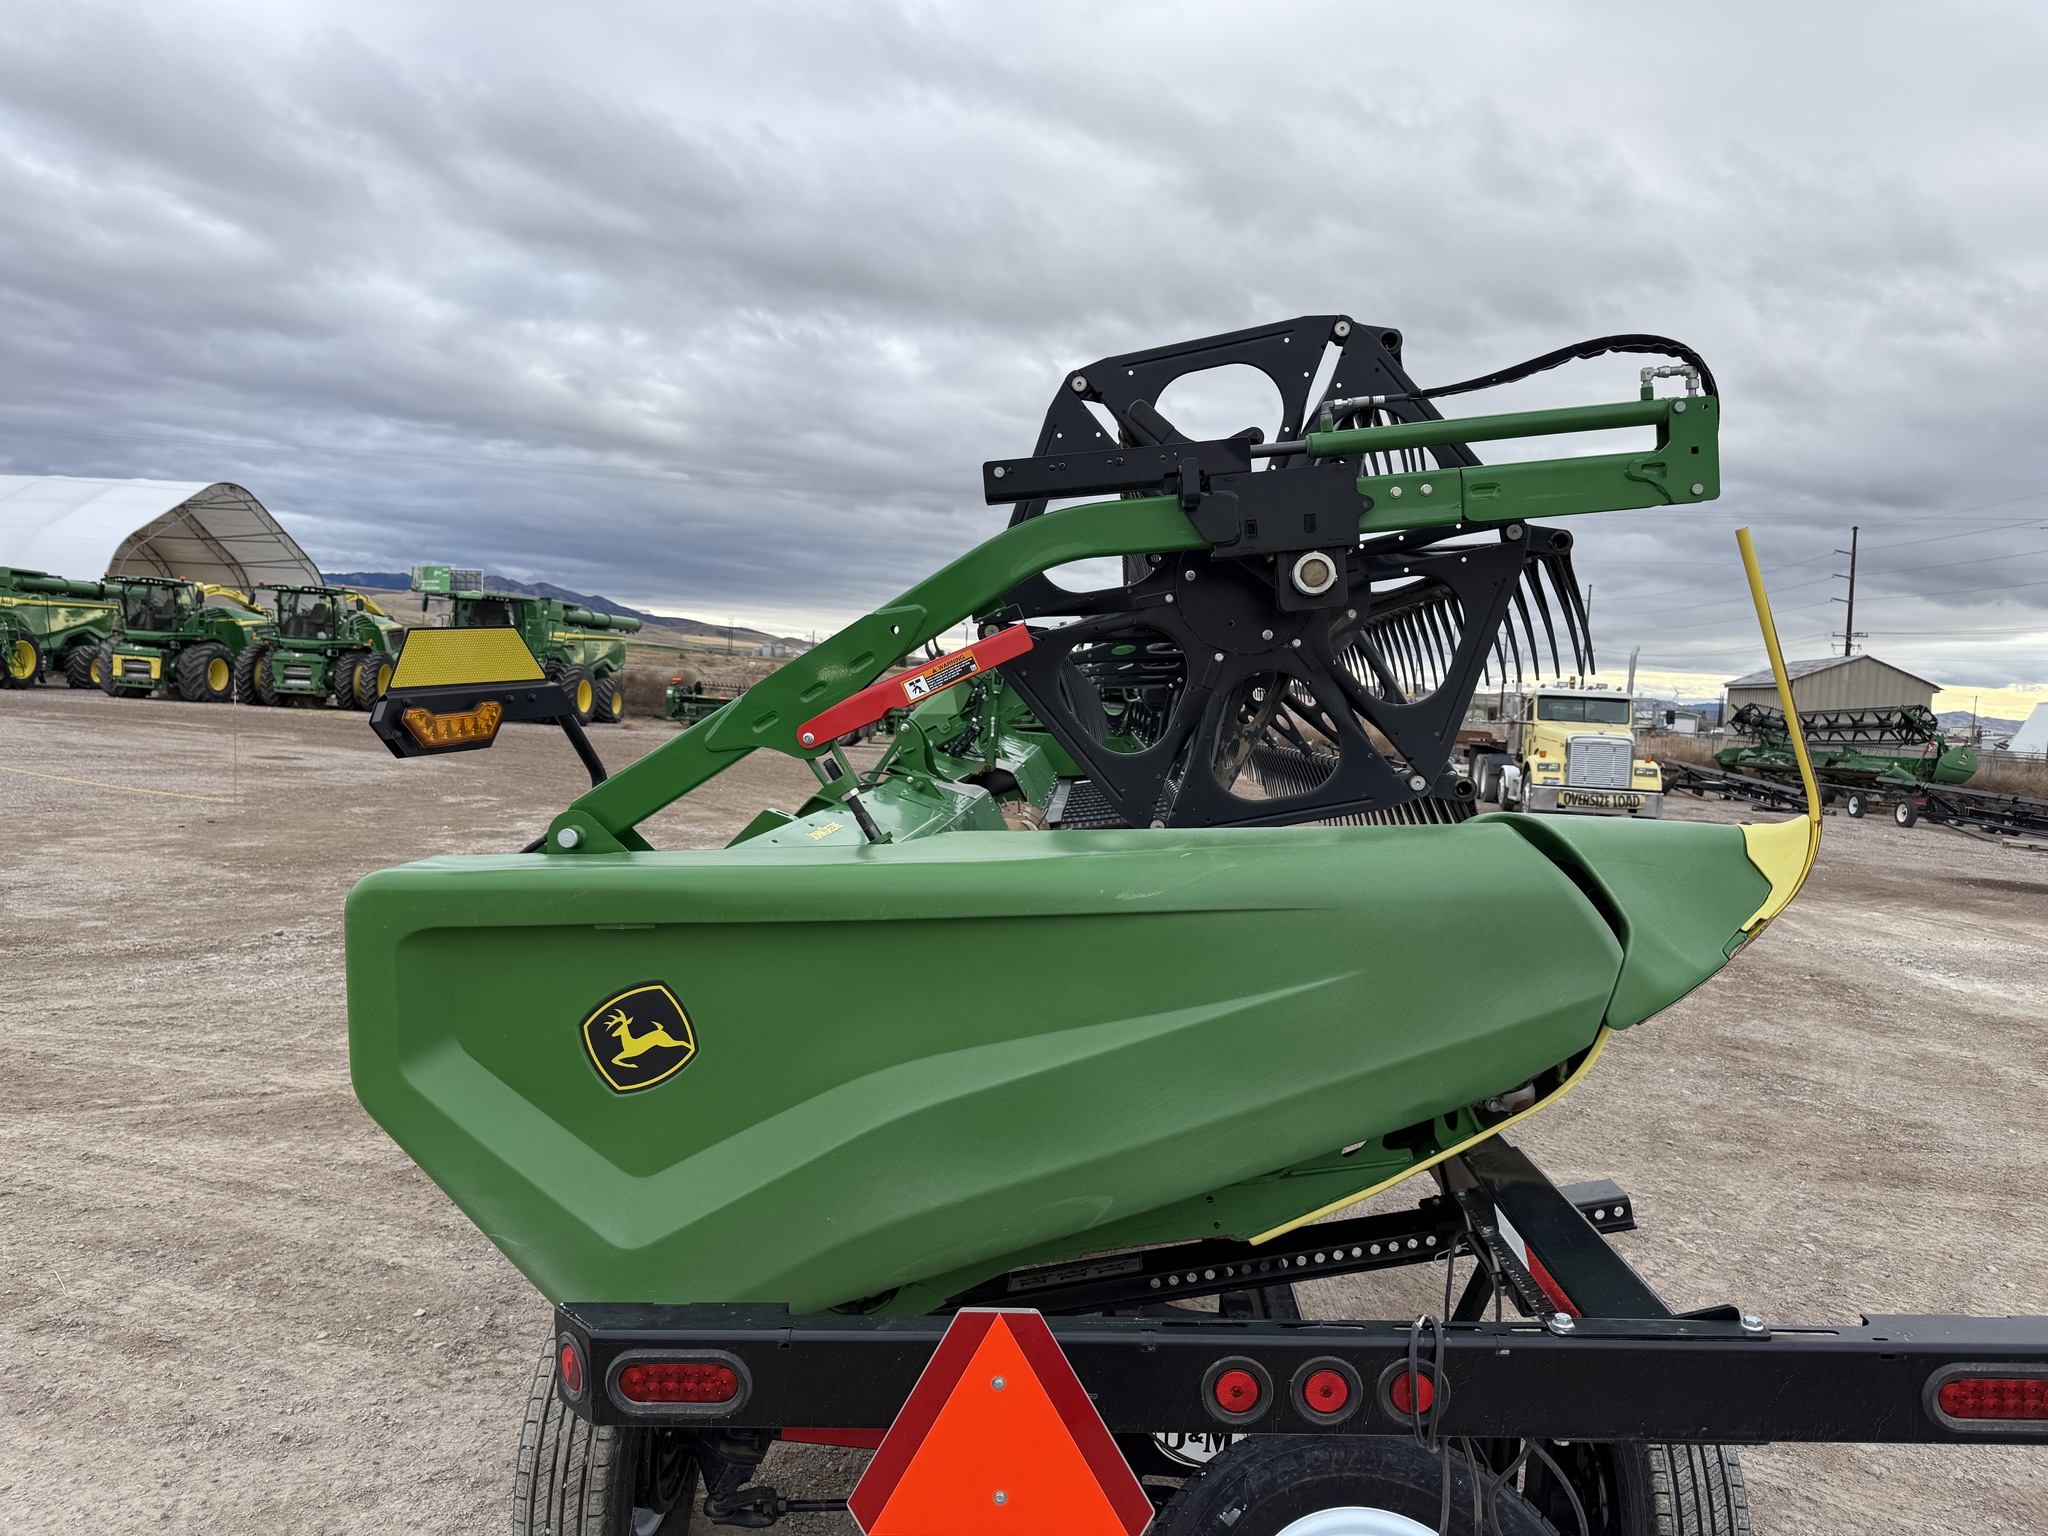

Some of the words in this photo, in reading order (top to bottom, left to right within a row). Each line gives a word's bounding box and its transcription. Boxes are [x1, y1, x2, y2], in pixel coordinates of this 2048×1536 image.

[1058, 462, 1067, 472] 3
[1116, 456, 1124, 466] 2
[938, 655, 966, 670] WARNING
[1563, 792, 1610, 807] OVERSIZE
[1613, 795, 1640, 808] LOAD
